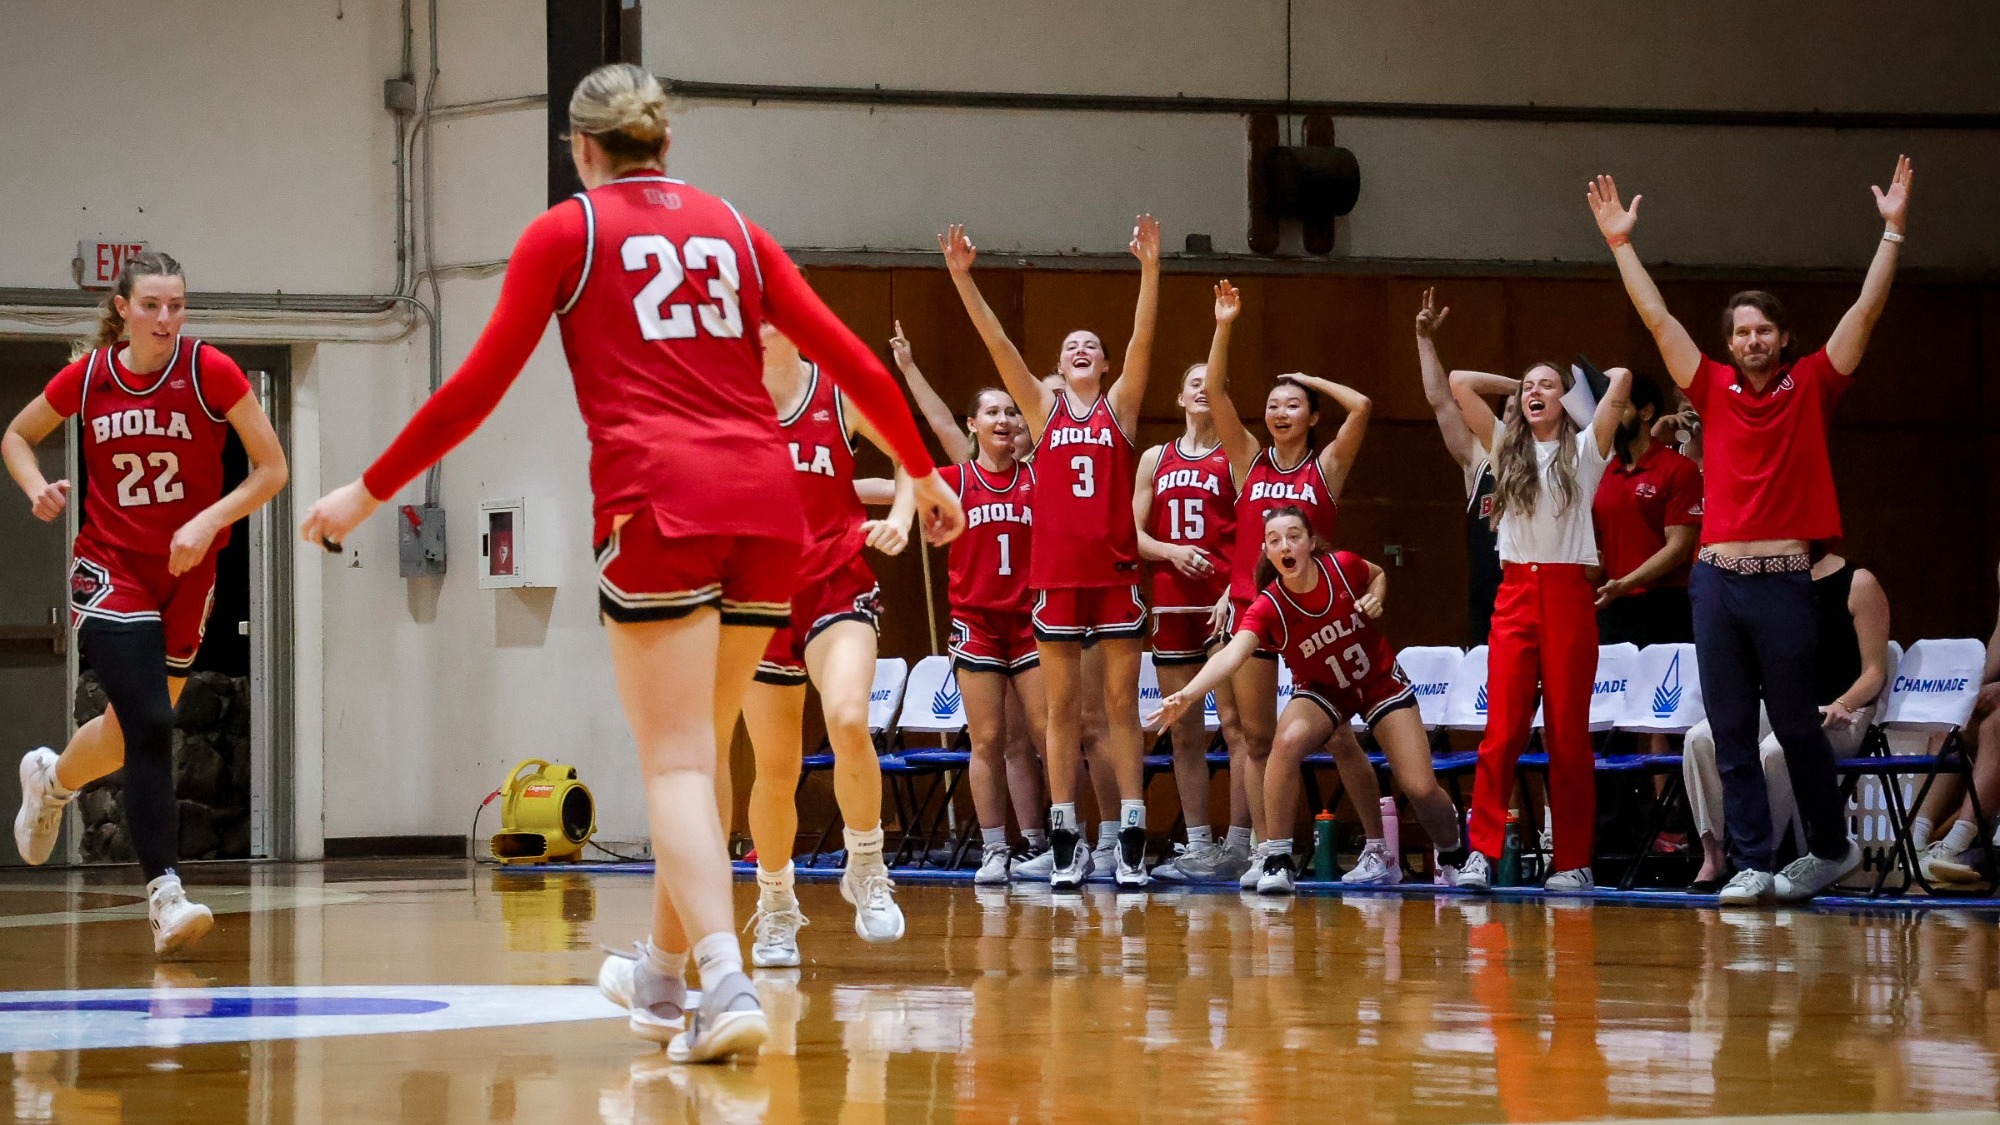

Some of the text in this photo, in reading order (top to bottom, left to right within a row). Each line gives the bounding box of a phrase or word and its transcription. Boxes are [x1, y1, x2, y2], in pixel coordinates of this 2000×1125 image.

[621, 235, 743, 340] 23
[92, 409, 192, 444] BIOLA
[1050, 427, 1113, 450] BIOLA
[112, 452, 184, 507] 22
[1071, 455, 1094, 498] 3
[1157, 469, 1220, 496] BIOLA
[1249, 481, 1318, 506] BIOLA
[968, 503, 1033, 529] BIOLA
[1168, 498, 1205, 540] 15
[997, 533, 1012, 576] 1
[1298, 612, 1366, 659] BIOLA
[1324, 643, 1371, 689] 13
[1893, 675, 1969, 693] CHAMINADE
